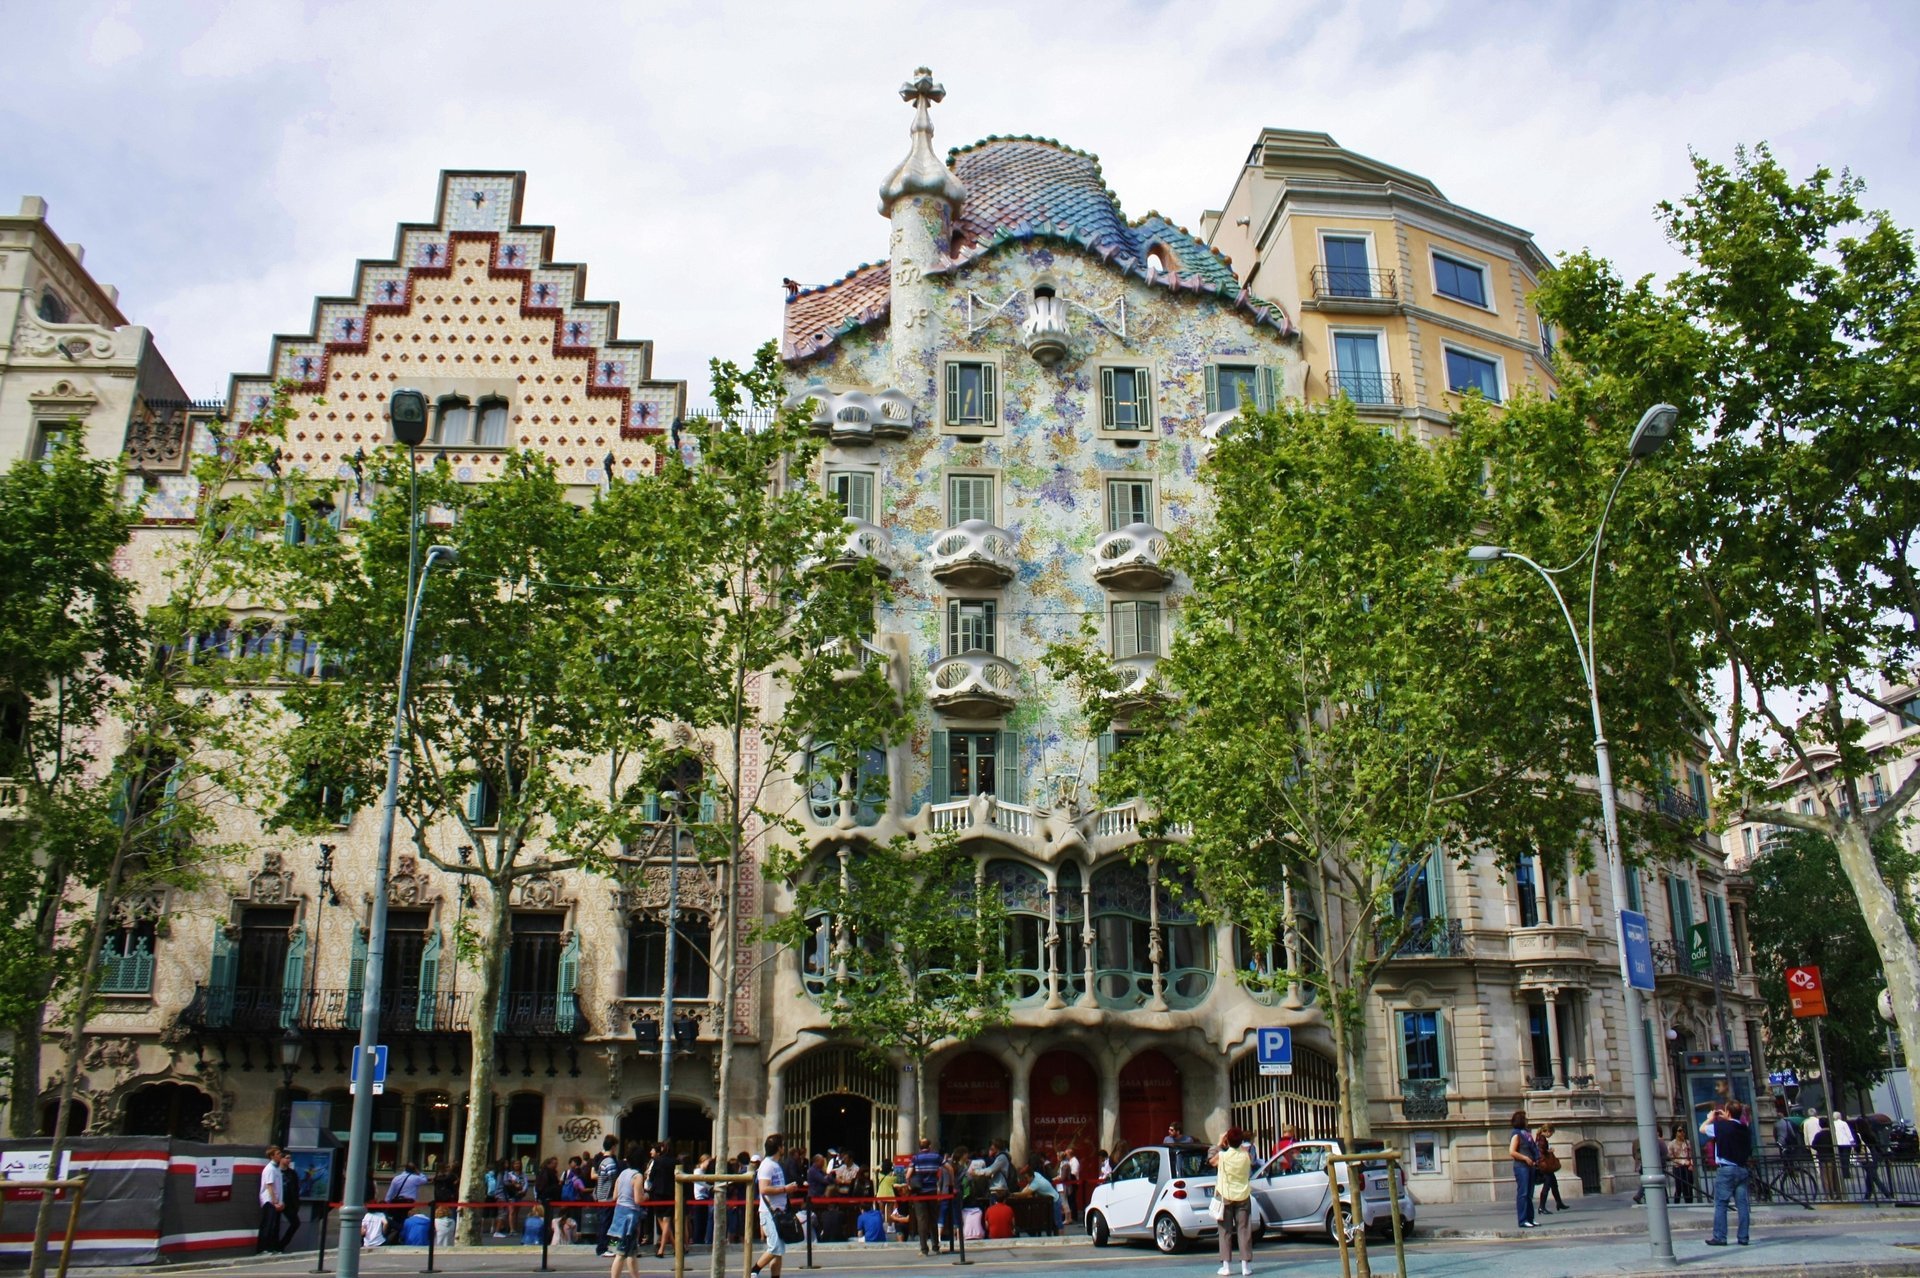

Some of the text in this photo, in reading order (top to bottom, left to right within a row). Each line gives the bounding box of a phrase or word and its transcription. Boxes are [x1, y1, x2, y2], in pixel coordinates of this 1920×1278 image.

[1691, 947, 1707, 960] adif
[1635, 959, 1646, 973] taxi
[1795, 974, 1806, 983] M
[1264, 1031, 1284, 1059] P
[1034, 1116, 1056, 1124] CASA
